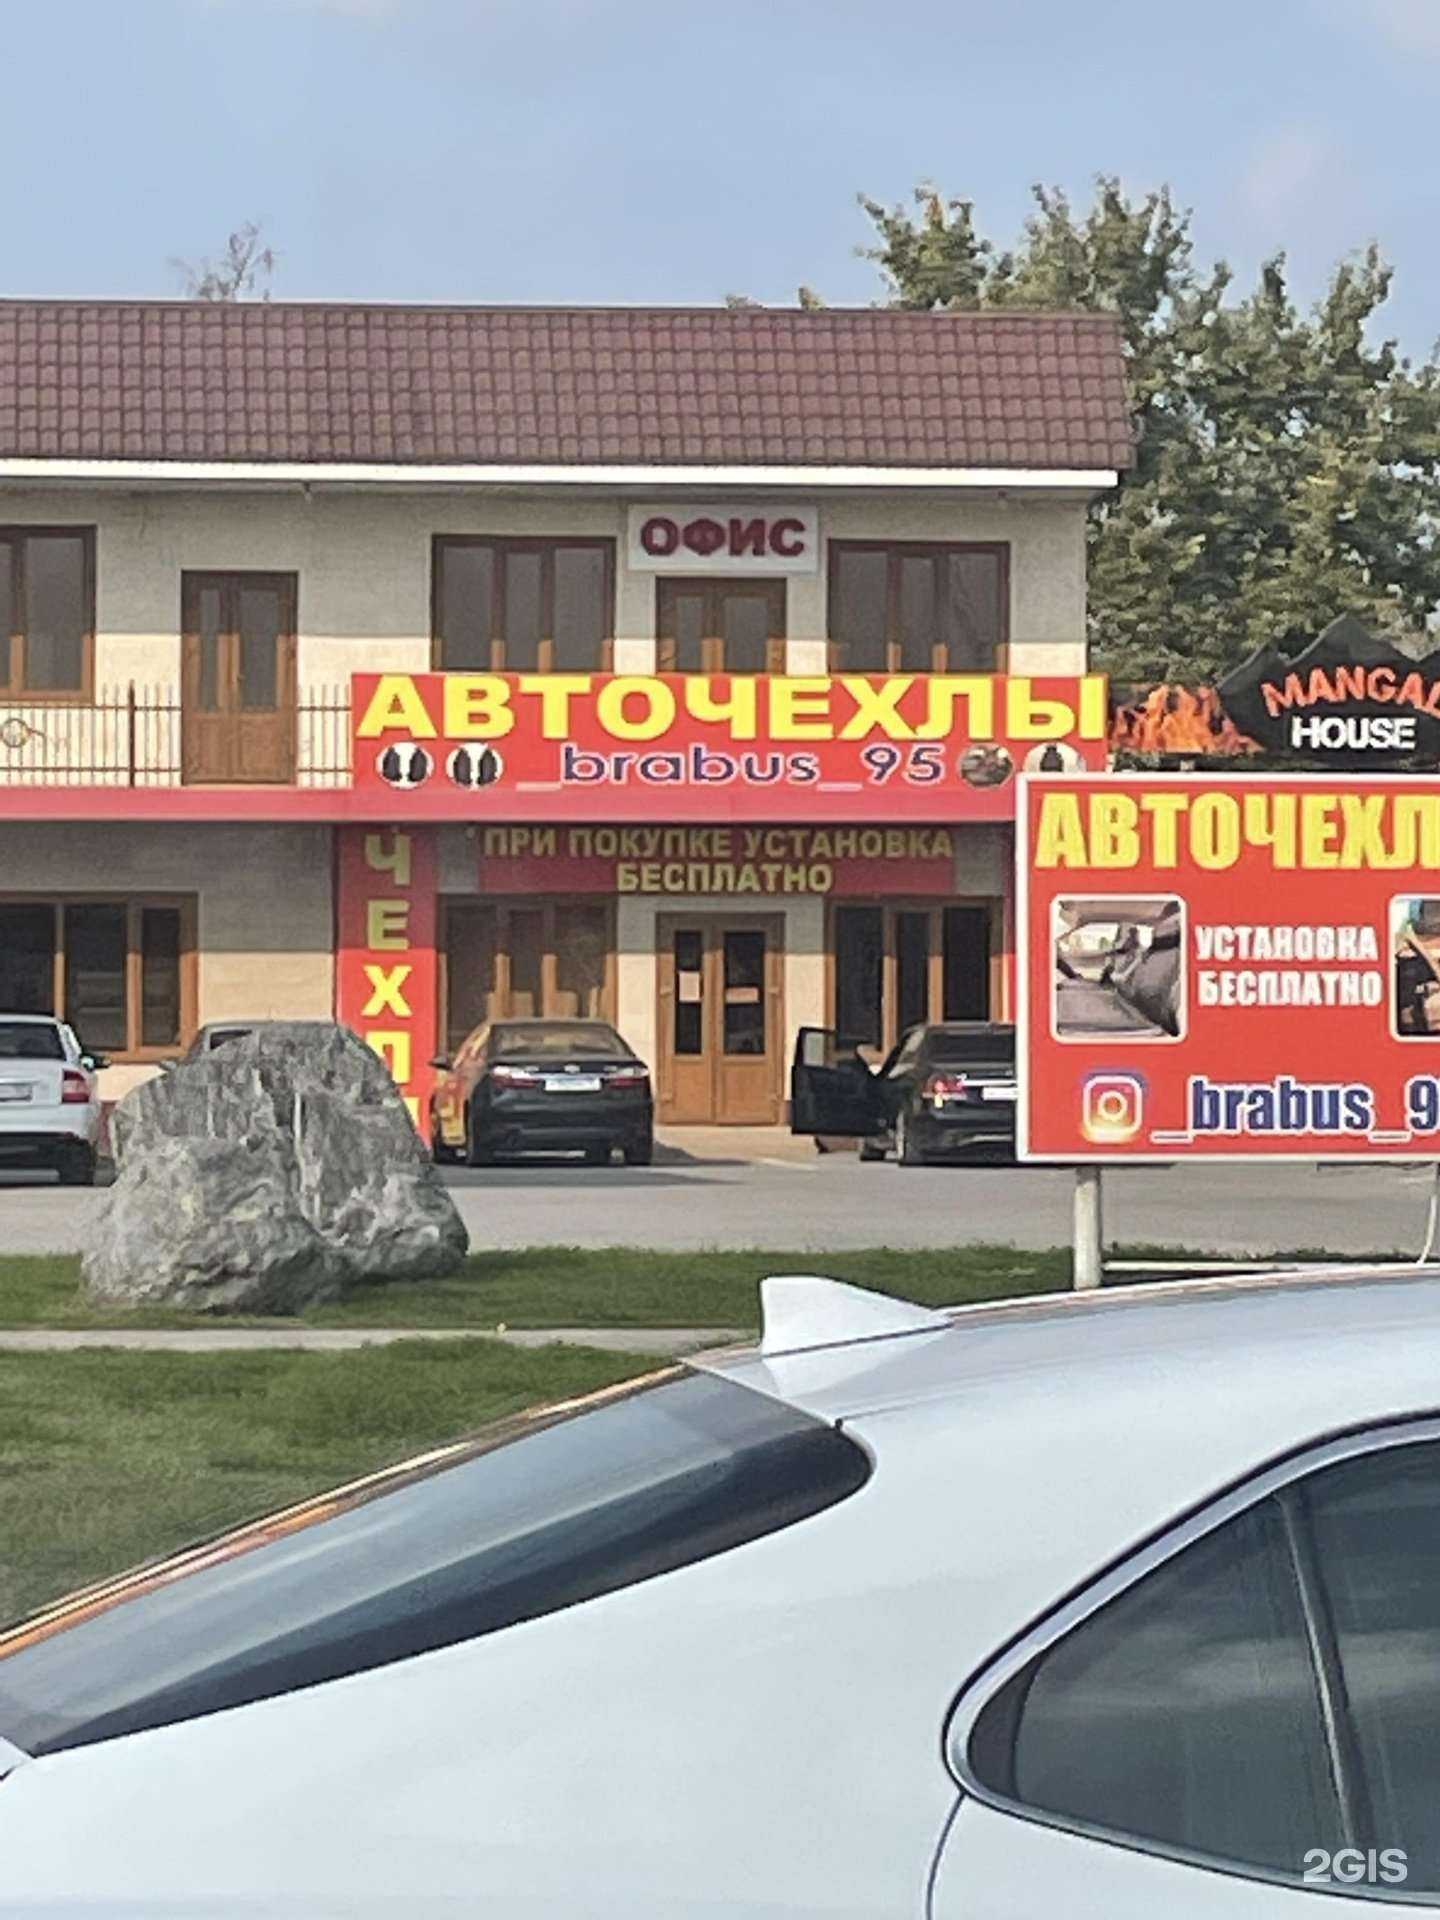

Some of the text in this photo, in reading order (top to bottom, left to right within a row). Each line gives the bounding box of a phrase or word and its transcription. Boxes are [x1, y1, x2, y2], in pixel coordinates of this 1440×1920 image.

[639, 516, 806, 558] ОФИС
[355, 675, 1106, 740] АВТОЧЕХЛЫ
[1260, 665, 1440, 718] MANGAL
[1291, 715, 1417, 749] HOUSE
[483, 828, 953, 858] ПРИ ПОКУПКЕ УСТАНОВКА
[1034, 792, 1440, 870] АВТОЧЕХЛ
[616, 862, 833, 893] БЕСПЛАТНО
[1194, 926, 1379, 962] УСТАНОВКА
[361, 833, 420, 1128] ЧЕХЛ
[1198, 971, 1382, 1007] БЕСПЛАТНО
